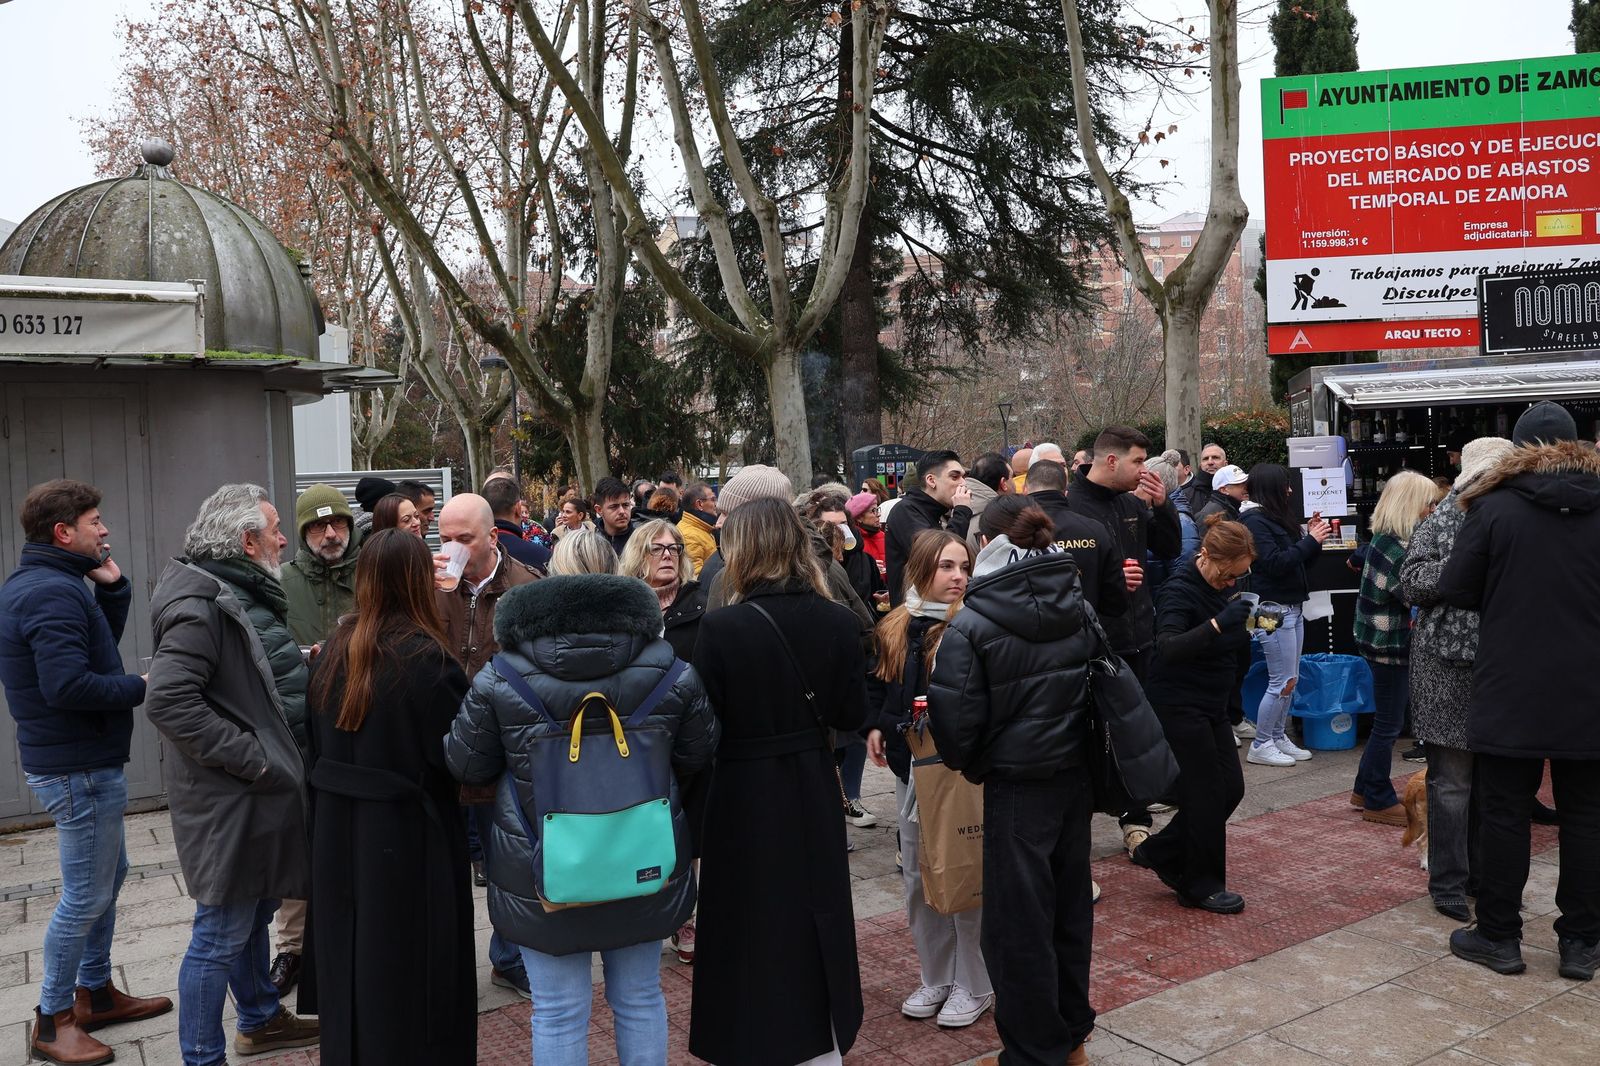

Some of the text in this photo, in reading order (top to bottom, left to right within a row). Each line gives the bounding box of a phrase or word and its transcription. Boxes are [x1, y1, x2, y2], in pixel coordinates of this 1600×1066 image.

[1319, 76, 1490, 107] AYUNTAMIENTO
[1498, 73, 1530, 94] DE
[1289, 147, 1389, 166] PROYECTO
[1394, 141, 1465, 160] BÁSICO
[1470, 140, 1482, 155] Y
[1488, 139, 1514, 154] DE
[1327, 158, 1590, 187] DEL MERCADO DE ABASTOS
[1348, 184, 1568, 209] TEMPORAL DE ZAMORA
[1301, 228, 1350, 238] Inversión:
[1463, 221, 1508, 231] Empresa
[1302, 237, 1369, 248] 1.159.998,31 €
[1463, 229, 1533, 241] adjudicataria:
[1350, 266, 1444, 281] Trabajamos
[1448, 265, 1490, 279] para
[13, 314, 46, 334] 633
[52, 315, 83, 335] 127
[1543, 329, 1584, 342] STREET
